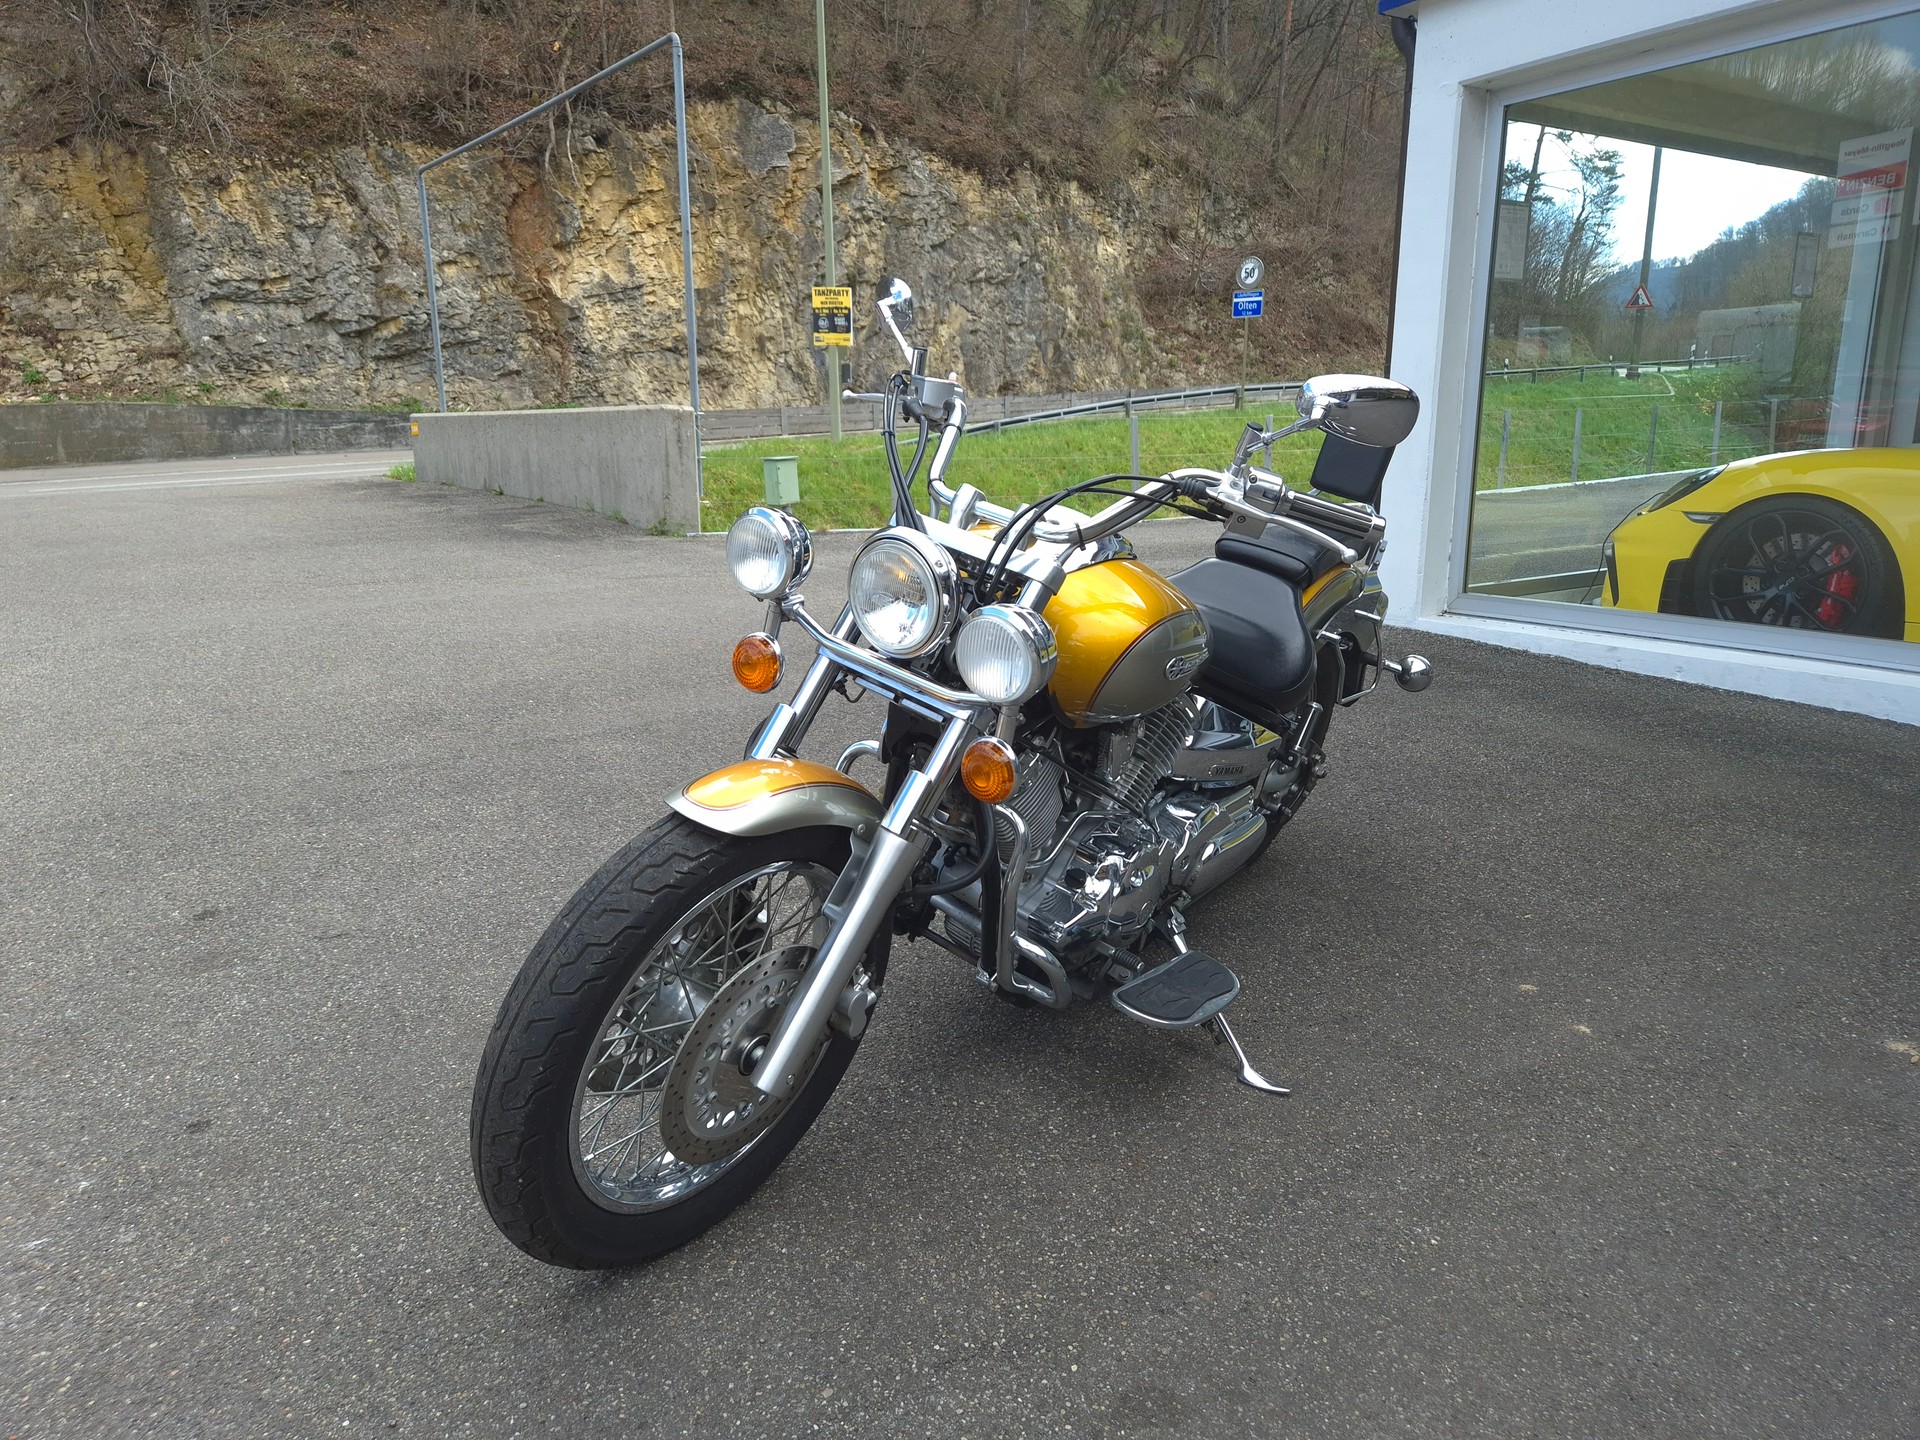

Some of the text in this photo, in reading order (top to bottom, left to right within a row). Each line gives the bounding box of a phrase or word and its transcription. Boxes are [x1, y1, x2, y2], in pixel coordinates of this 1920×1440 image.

[1244, 267, 1255, 279] 50
[813, 289, 850, 297] TANZPARTY
[1238, 302, 1257, 310] Olten
[1215, 765, 1244, 776] YAMAHA
